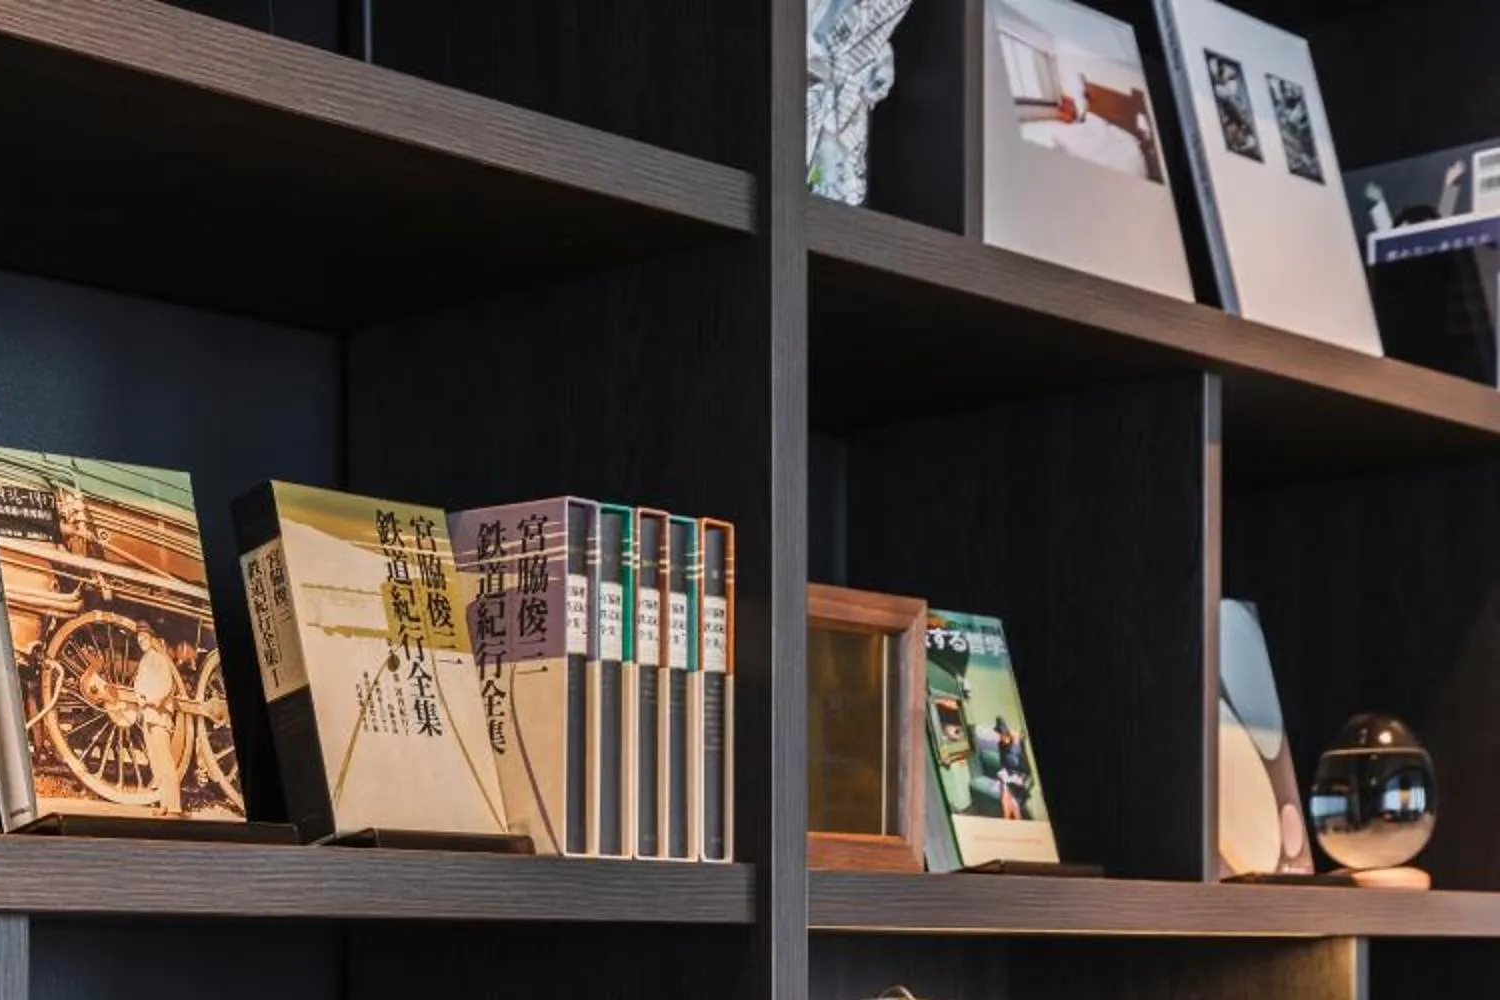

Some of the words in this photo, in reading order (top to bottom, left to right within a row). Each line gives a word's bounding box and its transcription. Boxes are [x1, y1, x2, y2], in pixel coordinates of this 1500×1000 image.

[375, 509, 443, 737] 鉄道紀行全集
[409, 514, 464, 665] 宮脇俊三
[517, 513, 549, 675] 宮脇俊三
